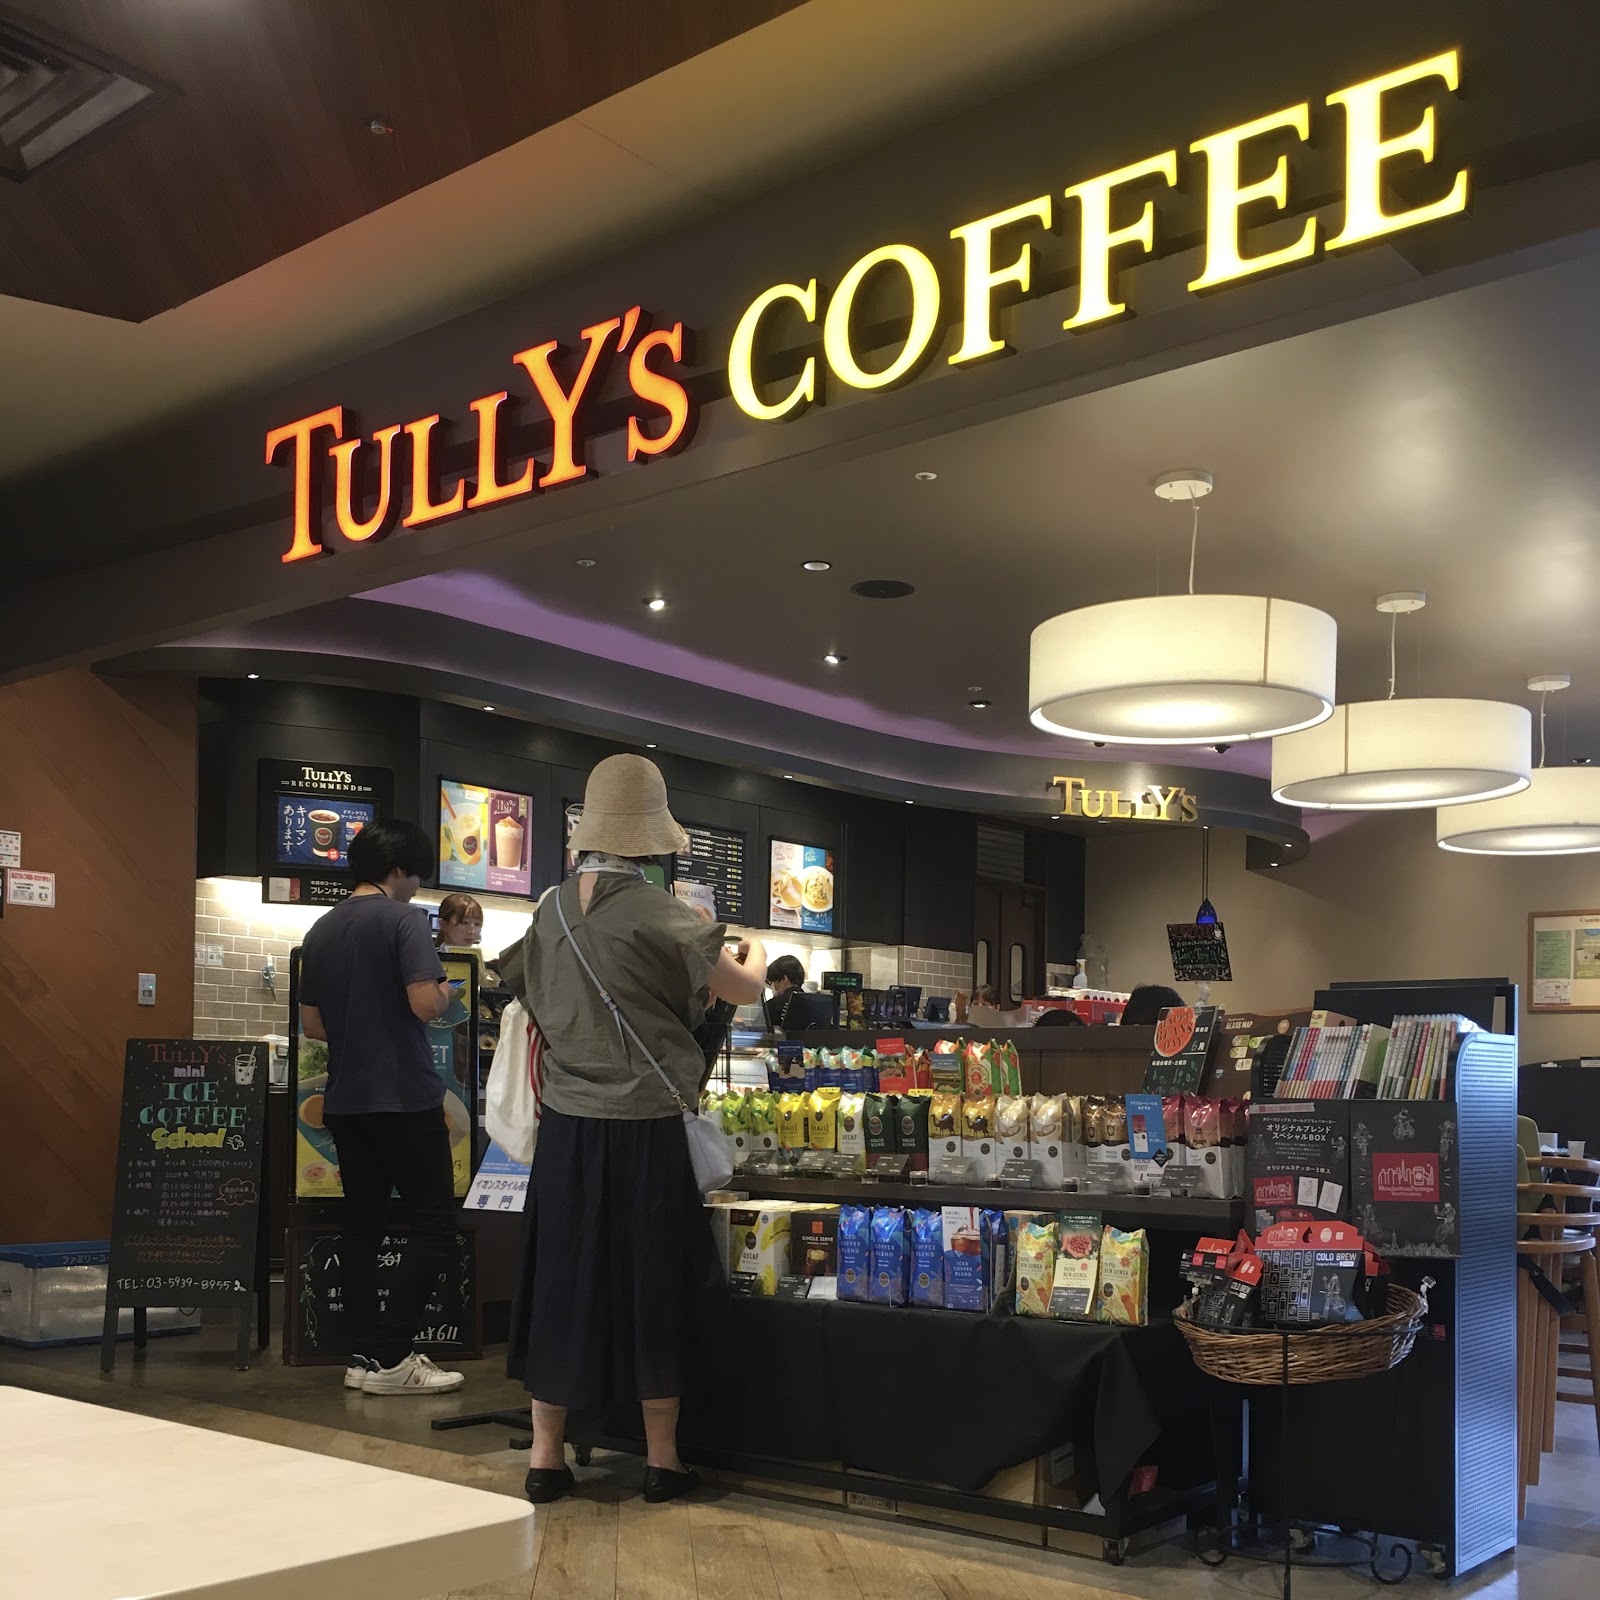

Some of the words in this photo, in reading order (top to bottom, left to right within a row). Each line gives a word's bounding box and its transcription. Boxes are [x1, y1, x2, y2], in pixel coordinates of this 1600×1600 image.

[727, 49, 1470, 423] COFFEE
[291, 780, 363, 792] RECOMMENDS
[282, 804, 294, 856] あります。
[296, 804, 307, 846] キリマン
[1241, 1020, 1254, 1029] MAP
[173, 1065, 205, 1078] mini
[162, 1079, 220, 1103] ICE
[139, 1104, 248, 1133] COFFEE
[1266, 1124, 1332, 1134] オリジナルブレンド
[151, 1126, 227, 1149] School
[1272, 1132, 1327, 1142] スペシャルBOX
[743, 1252, 759, 1260] DECAF
[1315, 1252, 1334, 1261] COLD
[1336, 1252, 1357, 1261] BREW
